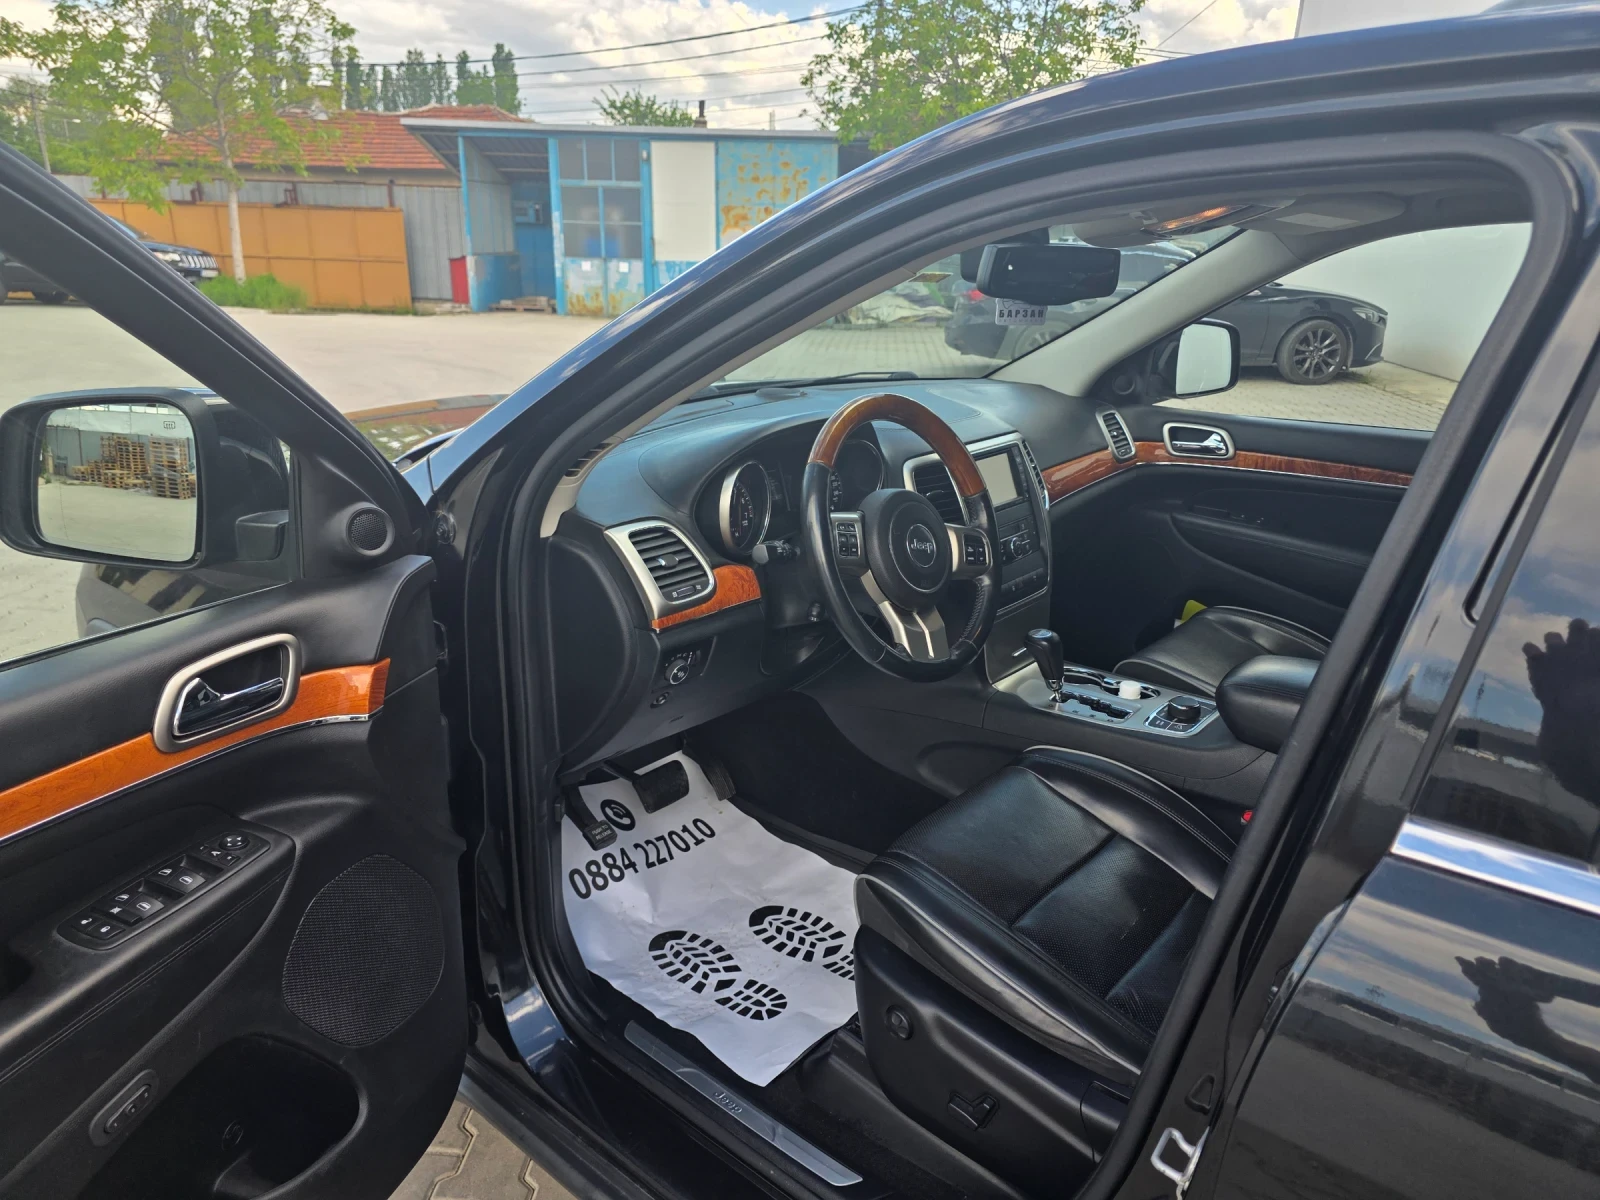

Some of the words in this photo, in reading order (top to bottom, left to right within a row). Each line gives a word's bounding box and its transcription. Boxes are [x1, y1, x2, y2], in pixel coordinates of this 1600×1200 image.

[999, 309, 1044, 318] БАРЗАН
[910, 538, 934, 554] Jeep
[568, 847, 639, 899] 0884
[633, 818, 716, 869] 227010
